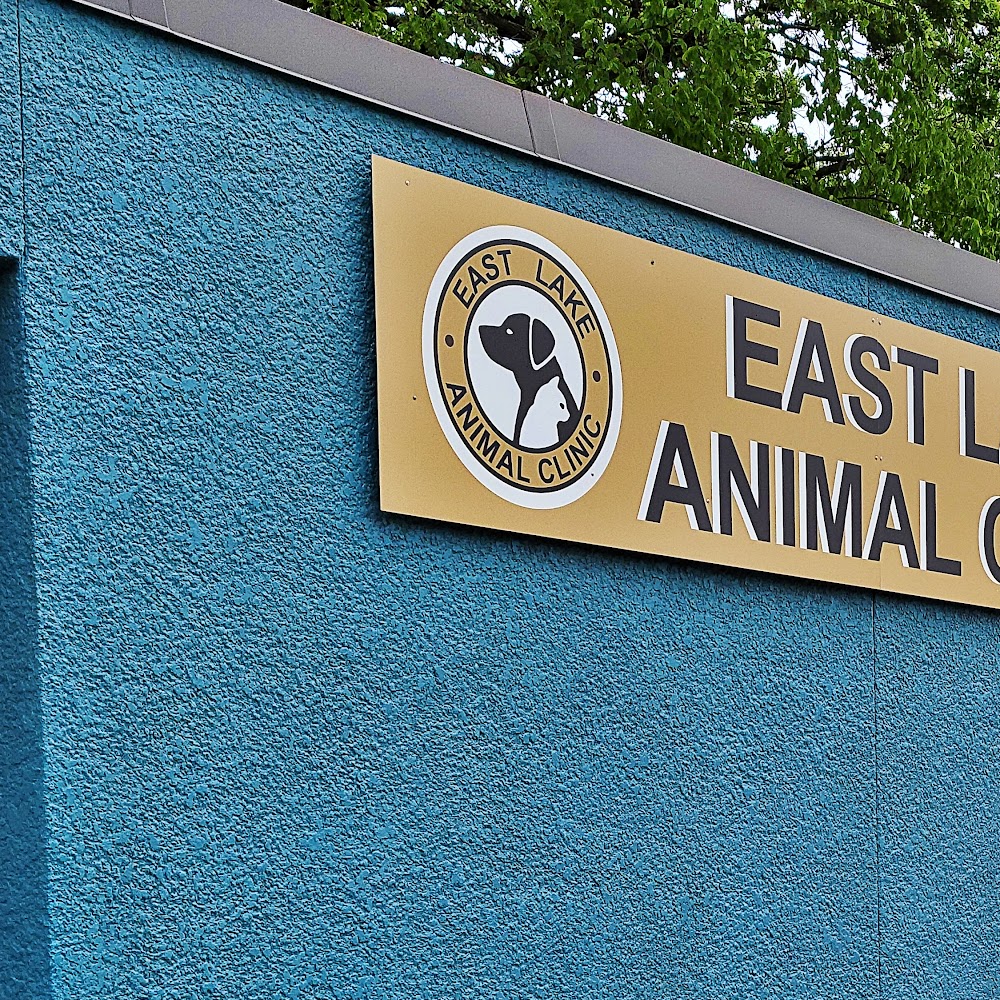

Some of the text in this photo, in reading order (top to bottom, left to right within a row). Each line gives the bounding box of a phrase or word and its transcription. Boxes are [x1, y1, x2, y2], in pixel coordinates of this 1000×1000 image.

[452, 249, 596, 339] EAST LAKE
[445, 382, 601, 484] ANIMAL CLINIC
[725, 294, 939, 446] EAST
[637, 419, 962, 577] ANIMAL
